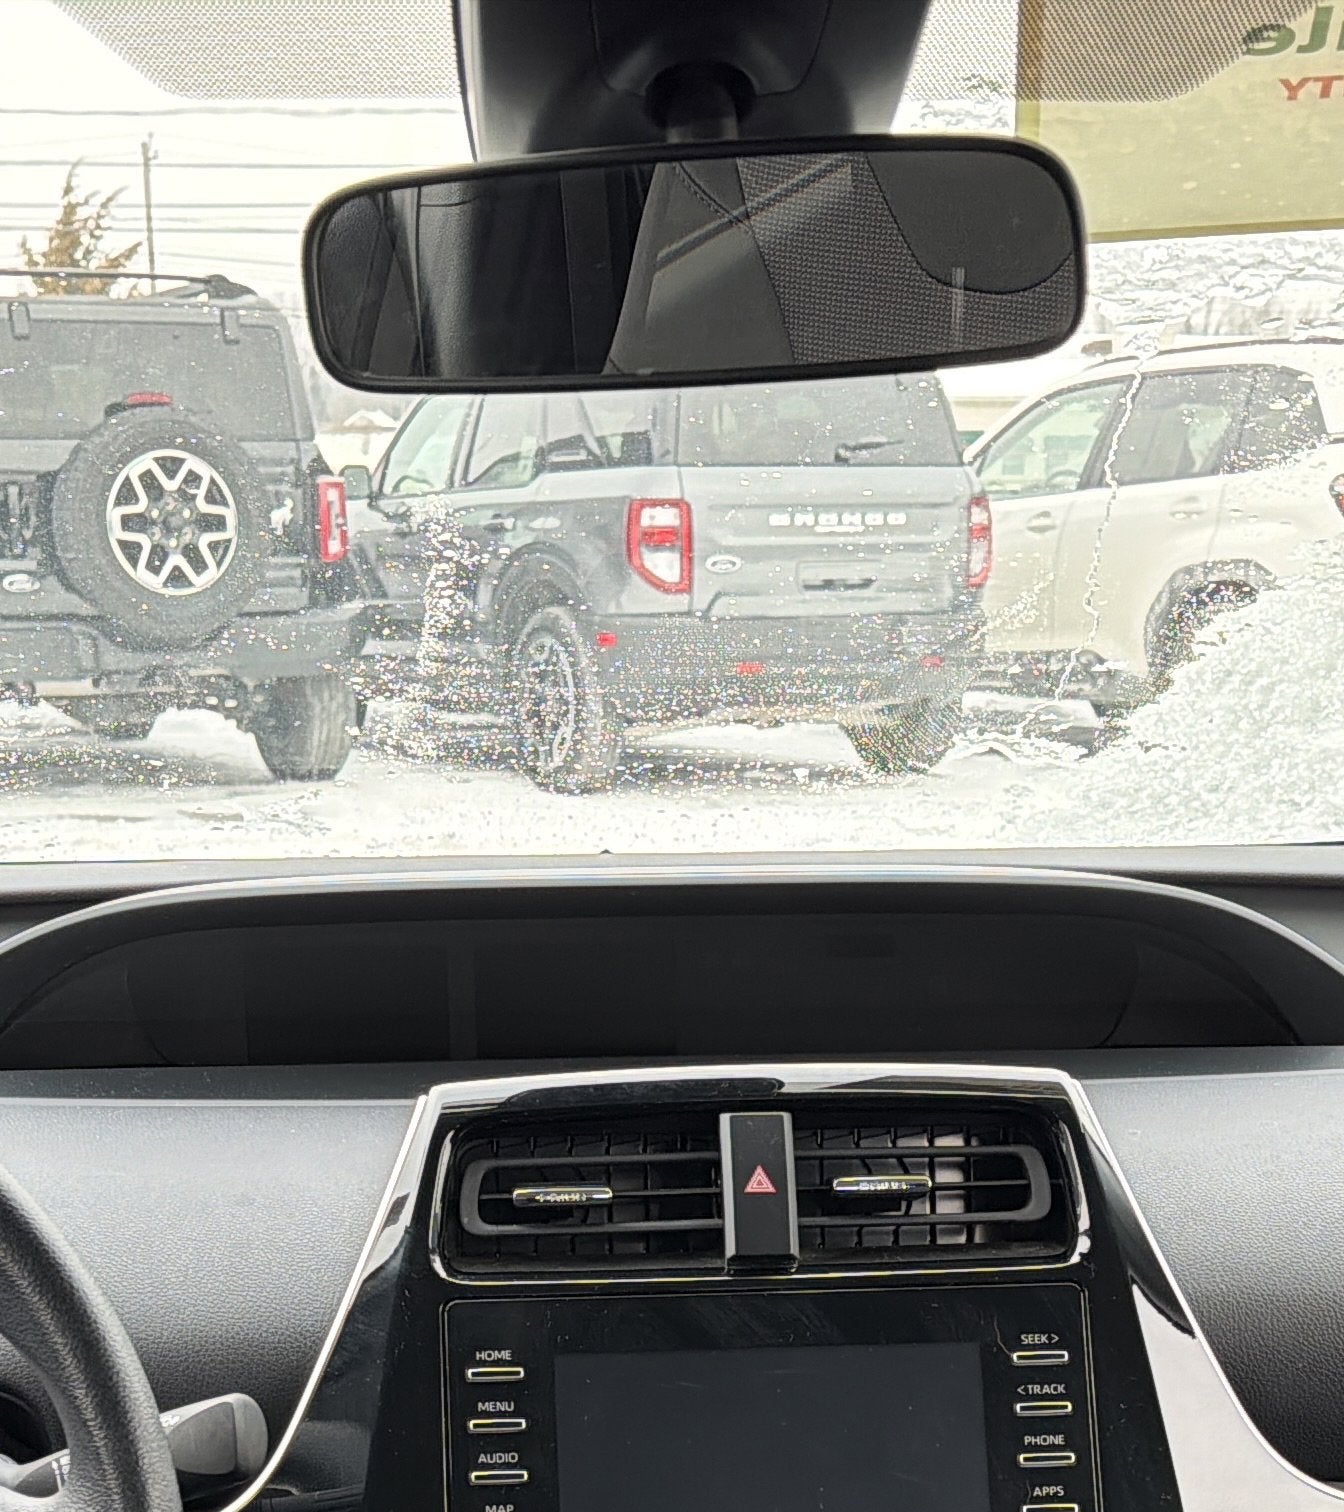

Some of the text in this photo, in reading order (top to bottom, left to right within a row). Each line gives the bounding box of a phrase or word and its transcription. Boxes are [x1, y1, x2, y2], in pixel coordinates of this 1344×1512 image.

[1020, 1333, 1050, 1345] SEEK
[475, 1350, 513, 1361] HOME
[1026, 1383, 1067, 1395] TRACK
[477, 1401, 515, 1412] MENU
[1023, 1434, 1066, 1446] PHONE
[477, 1452, 519, 1464] AUDIO
[1033, 1486, 1065, 1497] APPS
